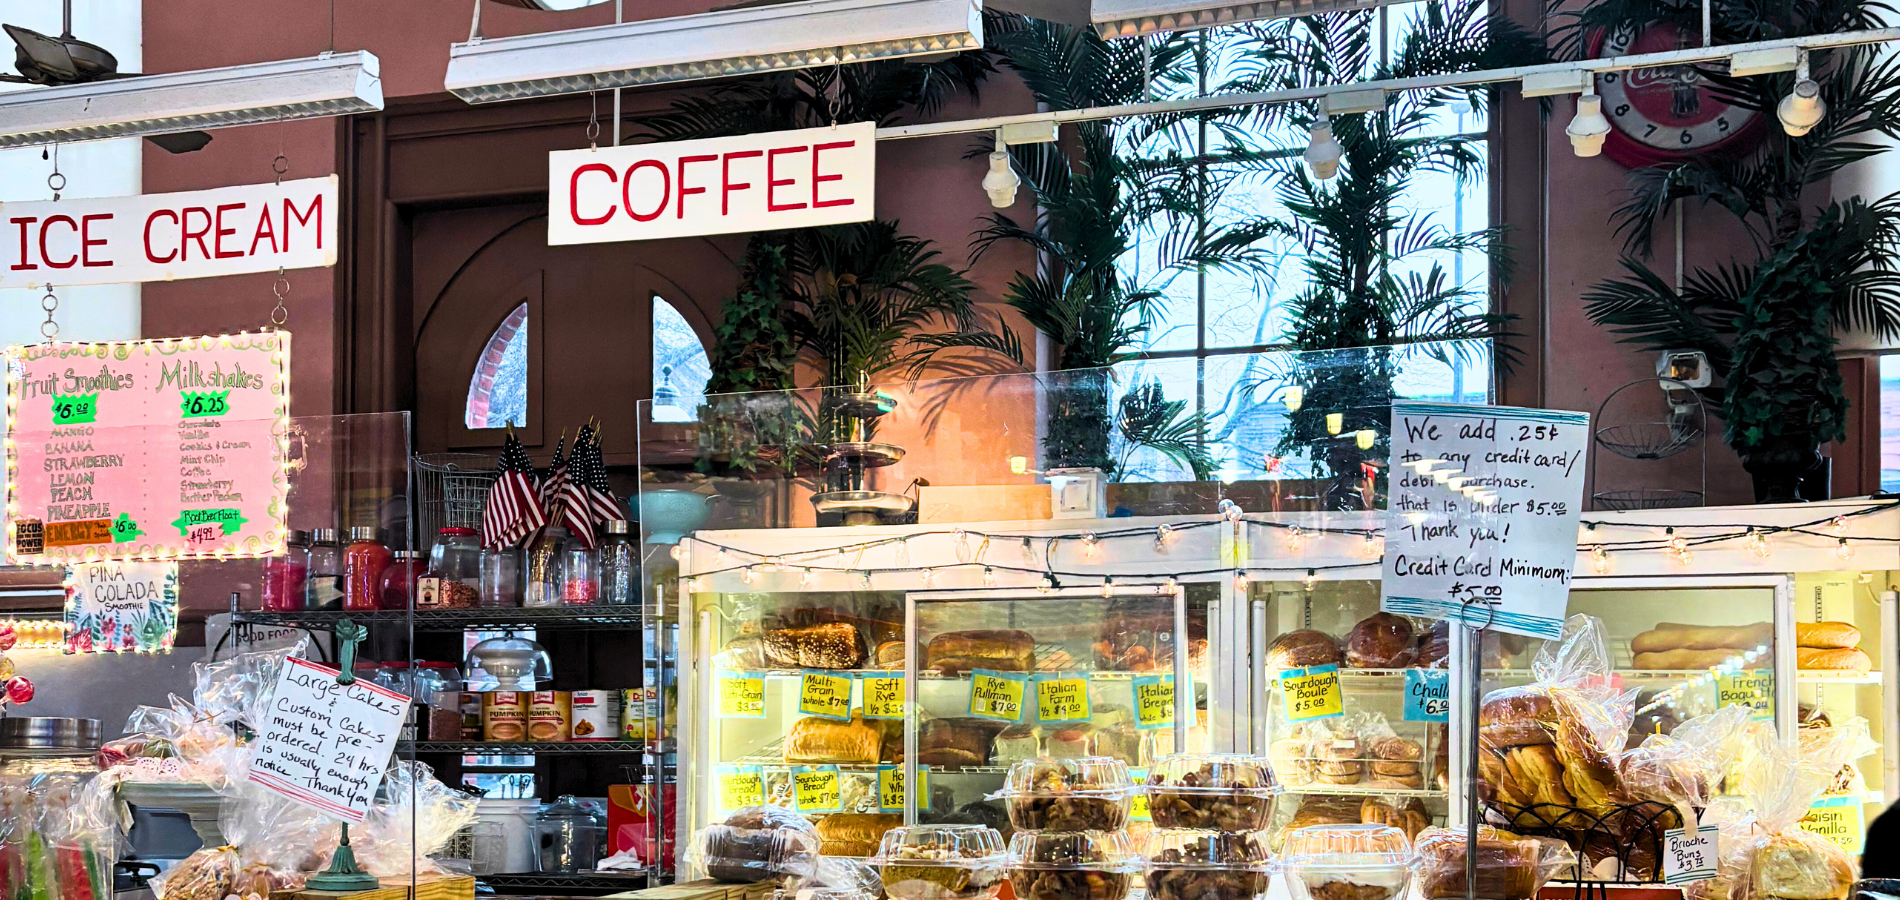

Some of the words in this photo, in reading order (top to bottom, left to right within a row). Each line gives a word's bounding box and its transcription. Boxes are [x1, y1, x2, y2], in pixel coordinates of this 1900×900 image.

[1615, 103, 1630, 117] 8
[1643, 123, 1658, 138] 7
[1717, 117, 1729, 132] 5
[1680, 129, 1693, 144] 6
[570, 140, 855, 225] COFFEE
[10, 213, 113, 270] ICE
[144, 194, 322, 263] CREAM
[22, 372, 59, 400] Fruit
[63, 364, 133, 393] Smoothies
[184, 396, 224, 415] $6.25
[52, 426, 94, 438] MANGO
[1404, 416, 1442, 443] We
[1459, 417, 1496, 442] add
[45, 440, 94, 455] BANANA
[44, 454, 124, 472] STRAWBERRY
[1439, 452, 1470, 473] any
[1485, 447, 1530, 464] credit
[50, 471, 94, 488] LEMON
[1400, 472, 1442, 487] debi
[50, 486, 93, 503] PEACH
[1396, 494, 1430, 511] that
[1443, 500, 1457, 512] is
[1526, 499, 1567, 515] $5.00
[47, 503, 110, 522] PINEAPPLE
[17, 523, 43, 533] FOCUS
[46, 522, 92, 542] ENERGY
[1401, 519, 1458, 542] Thank
[17, 539, 43, 547] POWER
[1395, 555, 1448, 577] Credit
[1453, 556, 1492, 577] Card
[95, 581, 158, 602] COLADA
[287, 662, 340, 700] Large
[347, 685, 400, 715] Cakes
[806, 675, 835, 687] Multi-
[875, 678, 899, 691] Soft
[988, 678, 1005, 691] Rye
[1041, 683, 1077, 694] Italian
[1284, 673, 1337, 692] Sourdough
[808, 685, 834, 695] Grain
[876, 691, 895, 702] Rye
[974, 687, 1011, 701] Pullman
[1297, 686, 1328, 699] Boule
[803, 696, 825, 706] whole
[1050, 695, 1074, 704] Farm
[1295, 698, 1325, 712] $5.00
[1416, 698, 1449, 714] $6.0
[273, 716, 304, 733] must
[311, 724, 328, 739] be
[277, 698, 333, 728] Custom
[340, 717, 386, 743] Cakes
[267, 730, 325, 757] ordered.
[334, 752, 353, 768] 24
[359, 756, 379, 775] hrs
[262, 743, 273, 754] is
[281, 751, 321, 777] usually
[327, 768, 368, 790] enough
[795, 774, 833, 784] Sourdough
[804, 782, 826, 791] Bread
[302, 776, 345, 798] Thank
[1669, 836, 1708, 851] Brioche
[1674, 850, 1701, 861] Buns
[1678, 857, 1705, 871] $3.75
